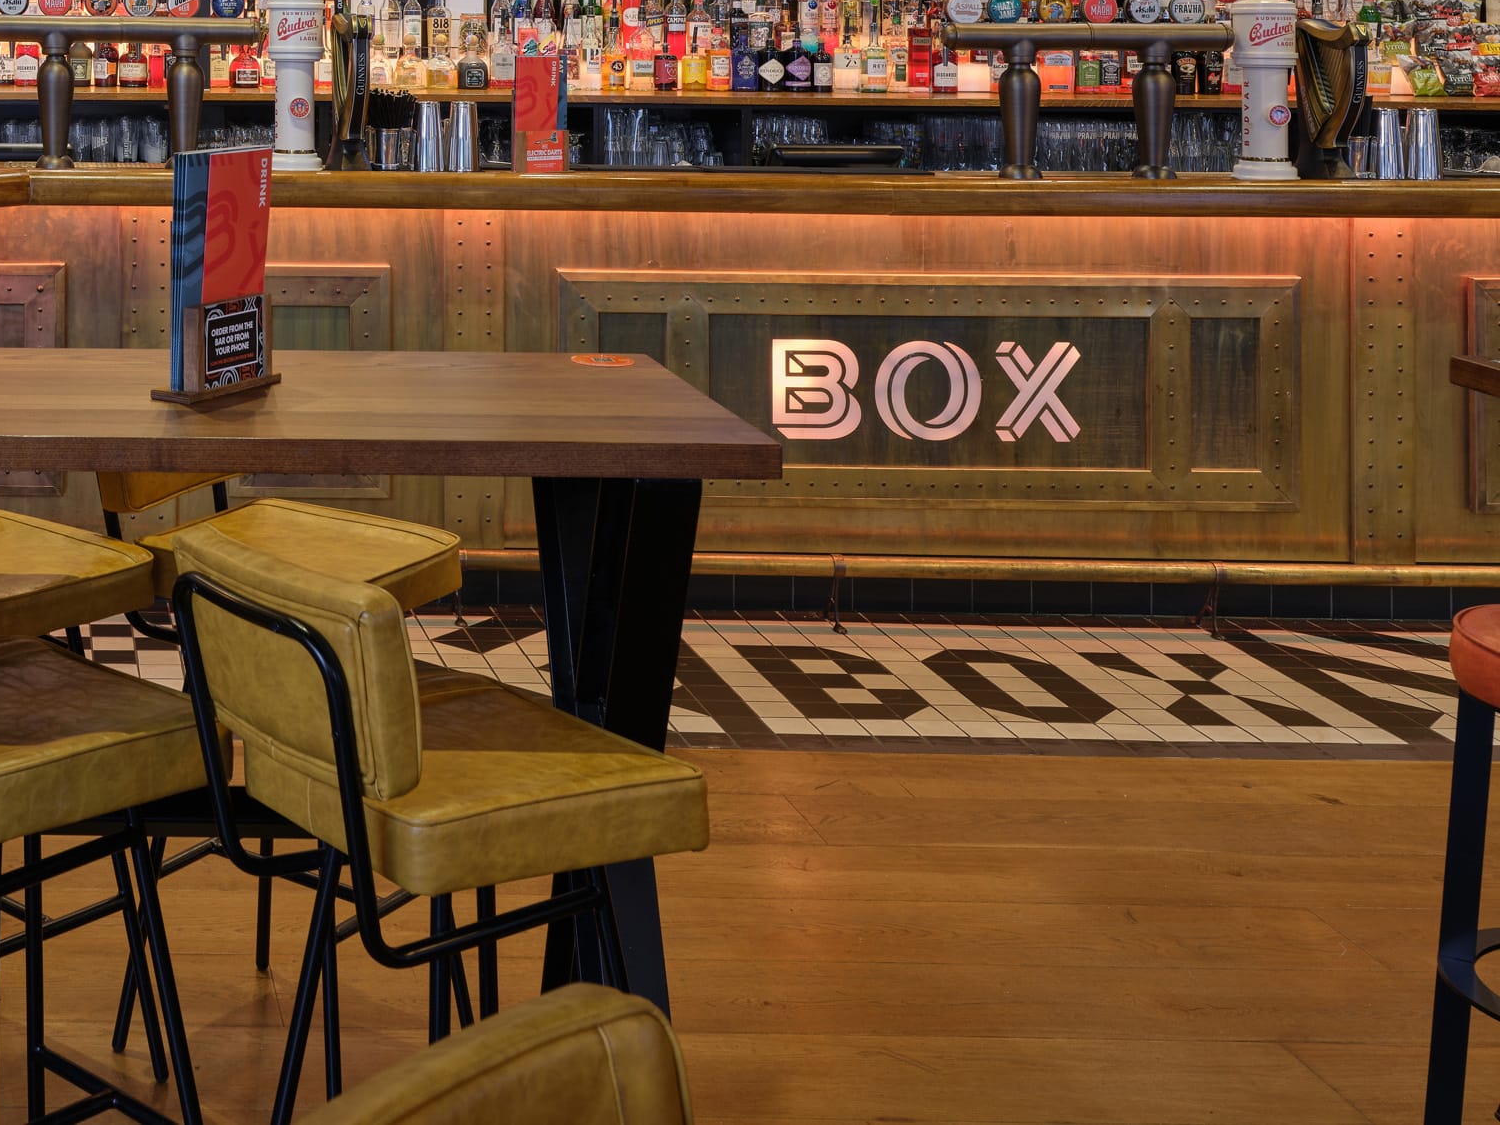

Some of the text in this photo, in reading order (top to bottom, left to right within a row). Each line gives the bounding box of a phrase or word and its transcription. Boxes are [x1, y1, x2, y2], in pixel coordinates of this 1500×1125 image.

[997, 1, 1015, 11] HAZY
[1174, 4, 1202, 14] PRAVHA
[999, 10, 1016, 20] JANE
[277, 16, 318, 37] Budvar
[433, 19, 450, 29] 818
[612, 62, 623, 70] 43
[356, 52, 366, 96] GUINNESS
[1353, 60, 1365, 104] GUINNESS
[259, 157, 268, 208] DRINK
[211, 321, 253, 337] ORDER FROM THE
[215, 332, 250, 347] BAR OR FROM
[215, 342, 250, 355] YOUR PHONE
[772, 339, 1081, 442] BOX
